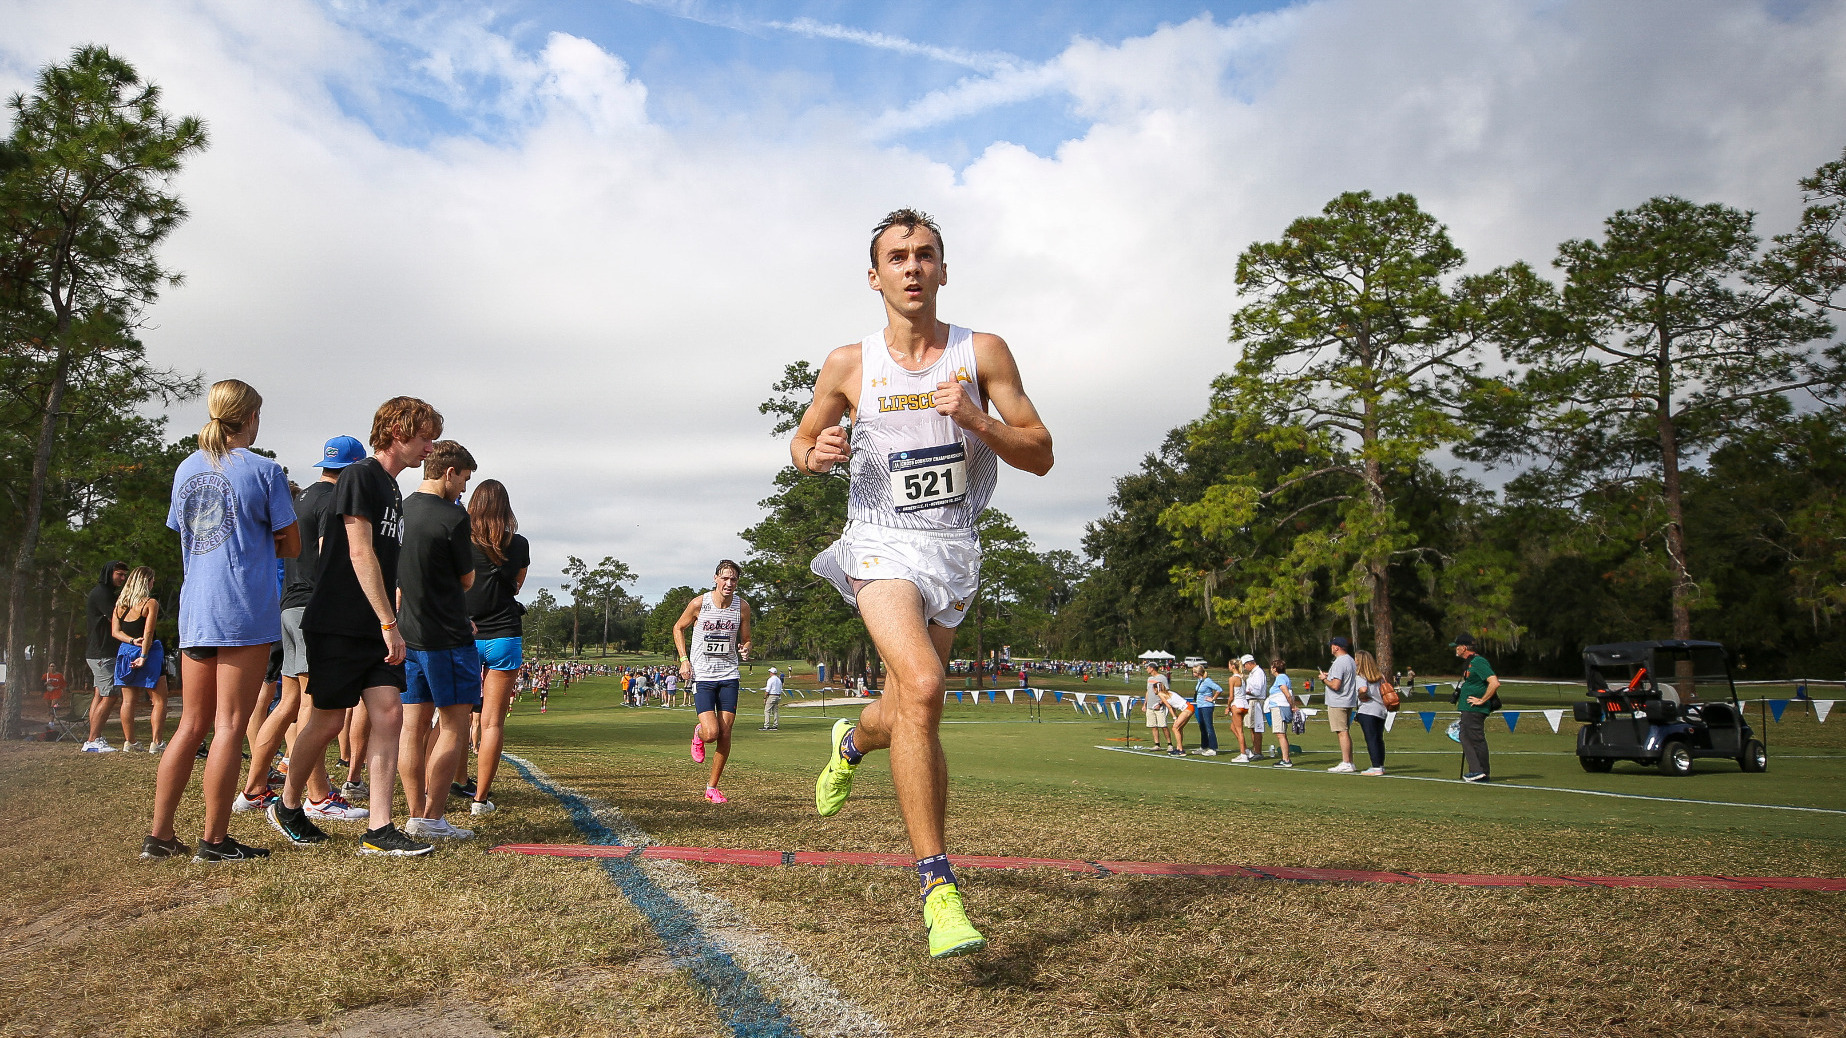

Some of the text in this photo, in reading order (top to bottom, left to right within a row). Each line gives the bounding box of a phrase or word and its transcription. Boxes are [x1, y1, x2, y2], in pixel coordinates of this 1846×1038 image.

[878, 390, 937, 413] LIPSCO
[209, 476, 230, 497] RIVER
[904, 468, 953, 500] 521
[390, 508, 397, 522] A
[380, 520, 396, 537] TH
[703, 620, 735, 631] Rebels
[707, 643, 724, 652] 571
